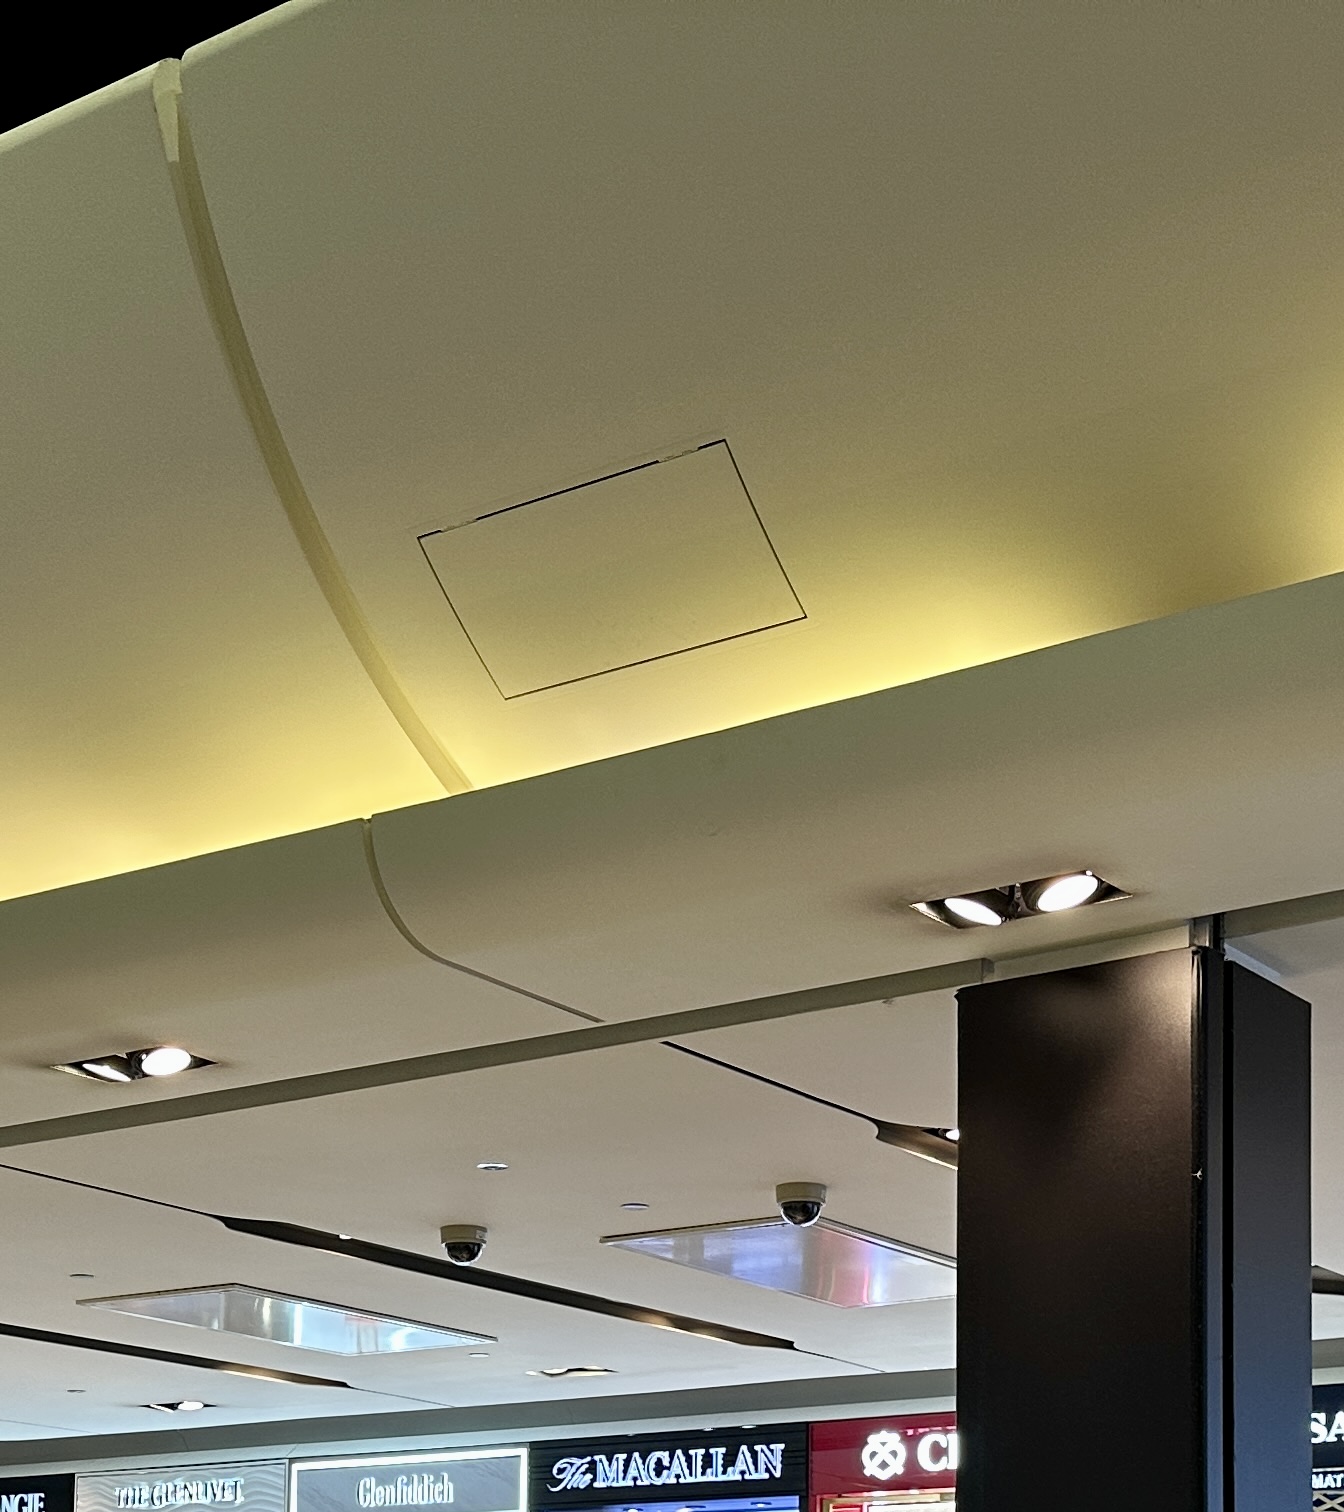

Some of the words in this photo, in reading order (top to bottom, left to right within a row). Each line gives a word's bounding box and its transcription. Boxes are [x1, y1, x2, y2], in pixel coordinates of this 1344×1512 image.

[546, 1456, 593, 1492] The
[593, 1443, 785, 1488] MACALLAN
[356, 1472, 454, 1508] Glenfiddich
